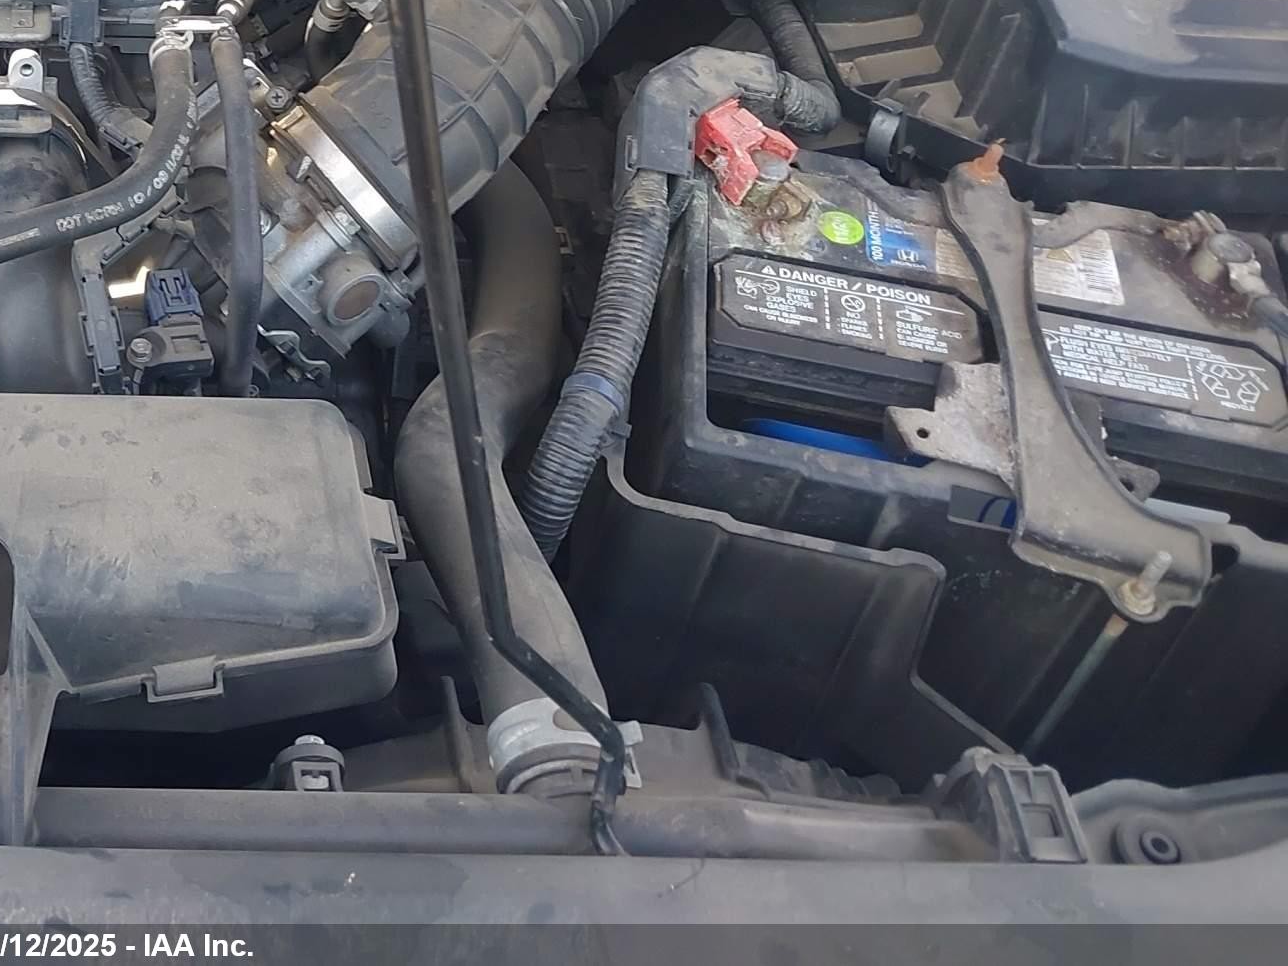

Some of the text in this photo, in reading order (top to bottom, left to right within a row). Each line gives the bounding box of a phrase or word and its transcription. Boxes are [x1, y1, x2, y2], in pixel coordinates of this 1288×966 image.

[868, 210, 884, 261] 100 MONTH
[778, 267, 931, 305] DANGER / POISON
[785, 285, 818, 297] SHIELD
[766, 295, 815, 310] EXPLOSIVE
[785, 293, 810, 303] EYES
[846, 311, 861, 320] NO
[896, 321, 940, 335] SULFURIC
